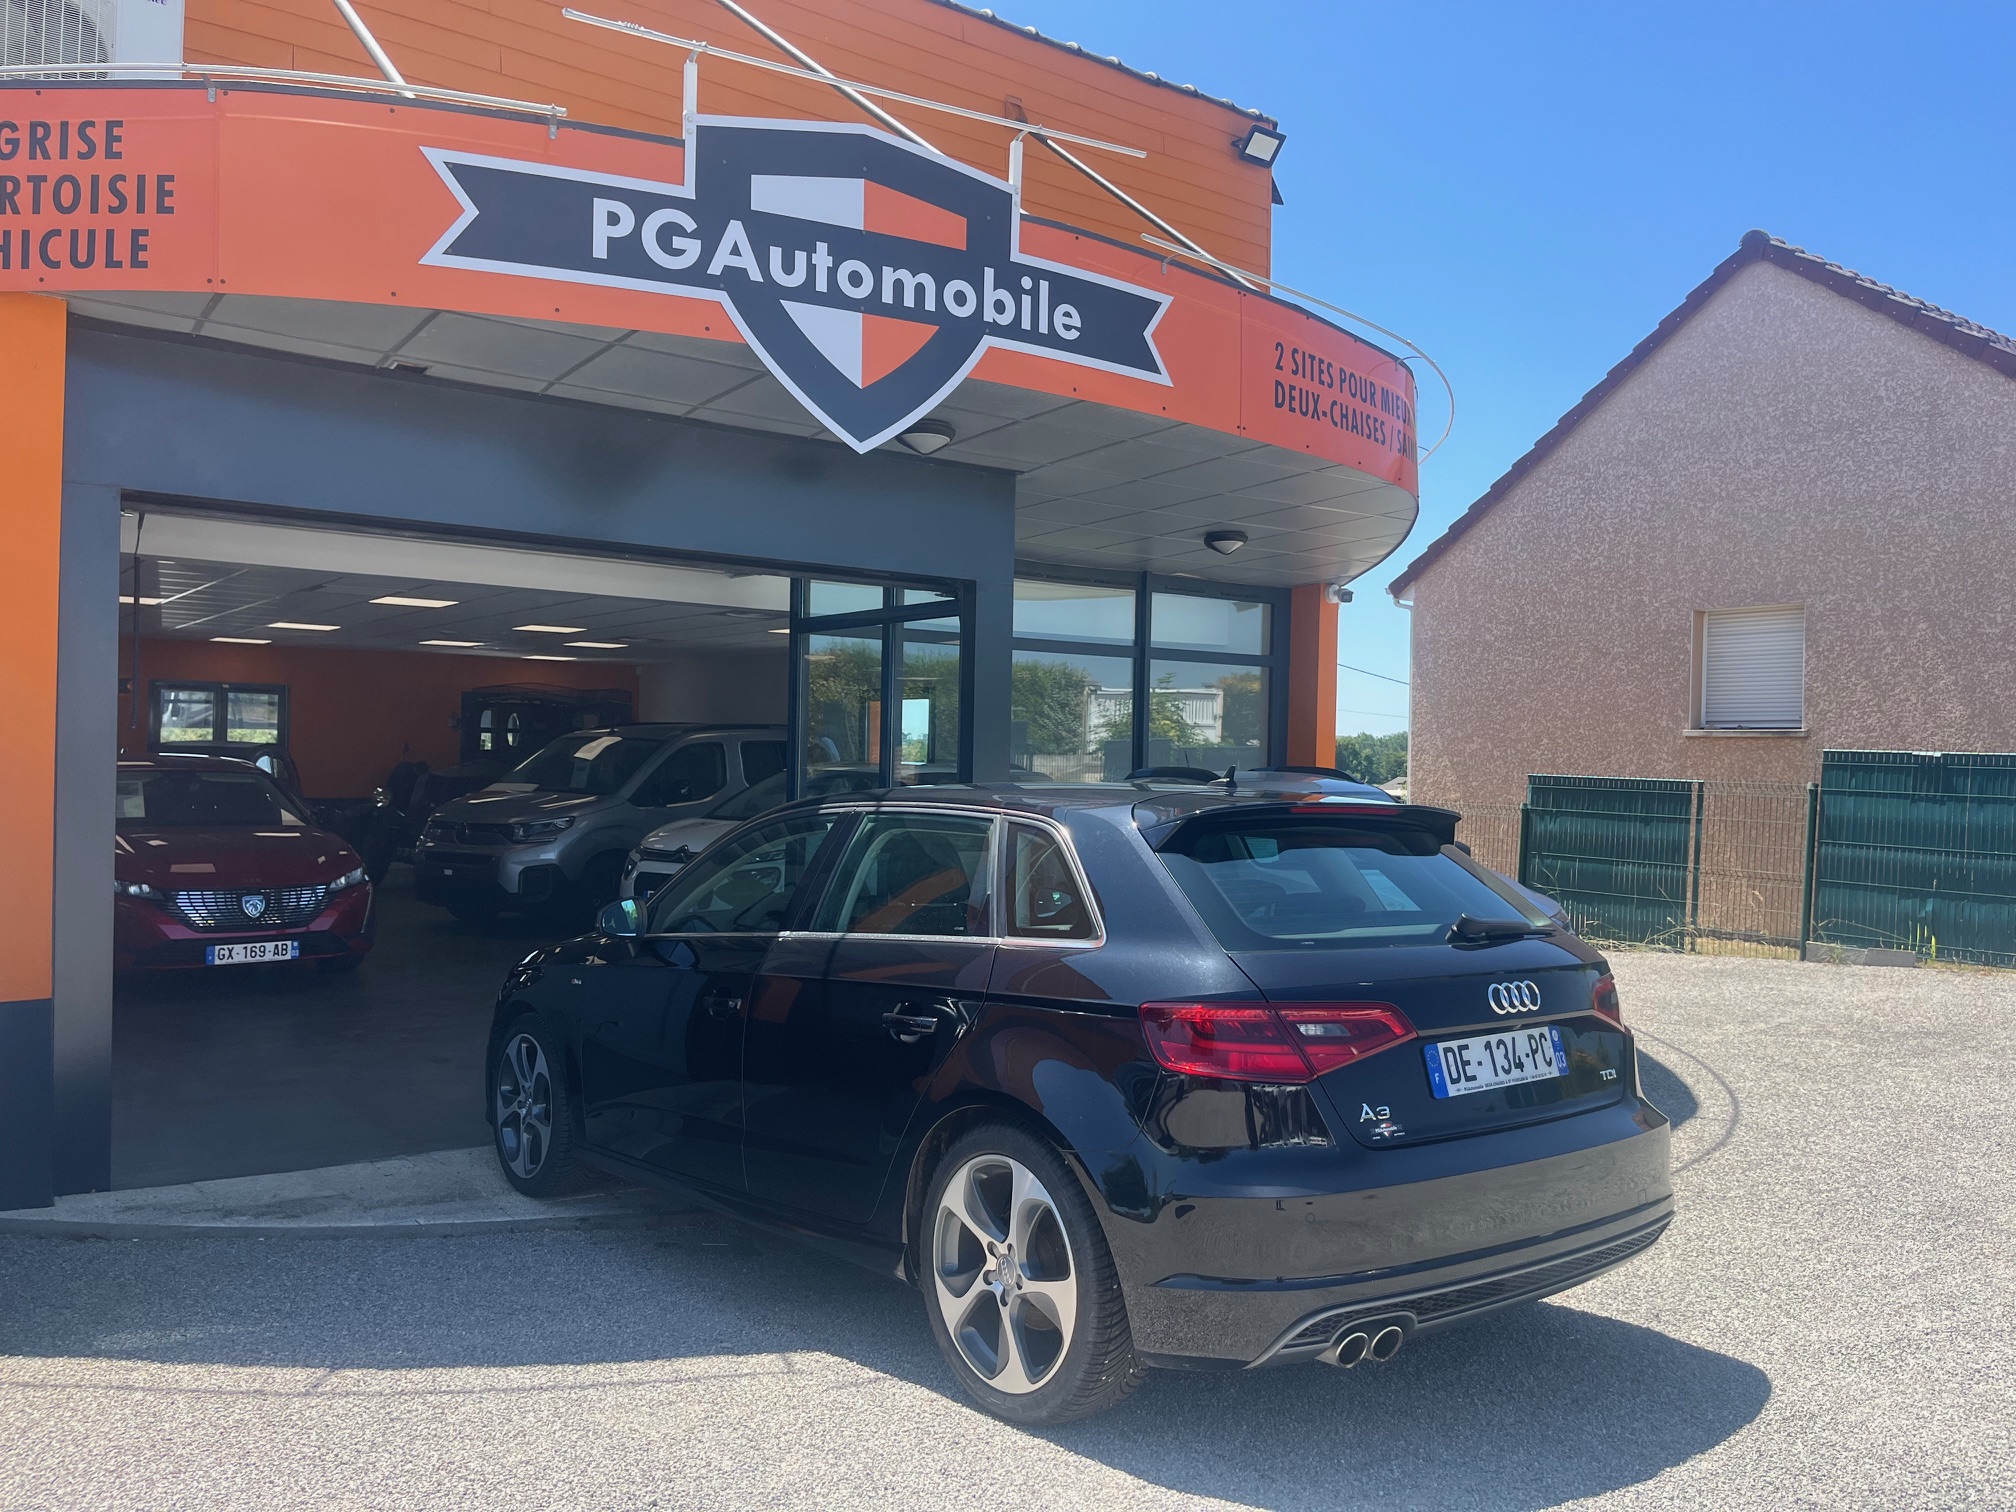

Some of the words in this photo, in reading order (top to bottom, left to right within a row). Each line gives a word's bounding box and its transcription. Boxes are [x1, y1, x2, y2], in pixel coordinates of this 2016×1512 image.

[0, 120, 124, 160] GRISE
[0, 174, 175, 214] RTOISIE
[592, 197, 1082, 341] PGAutomobile
[1275, 341, 1284, 371] 2
[1291, 347, 1334, 389] SITES
[1339, 366, 1376, 409] POUR
[1274, 379, 1386, 446] DEUX-CHAISES
[217, 943, 288, 961] GX-169-AB
[1442, 1032, 1553, 1086] DE-134-PC
[1555, 1051, 1567, 1068] 03
[1599, 1068, 1617, 1081] TDI
[1359, 1102, 1391, 1123] A3
